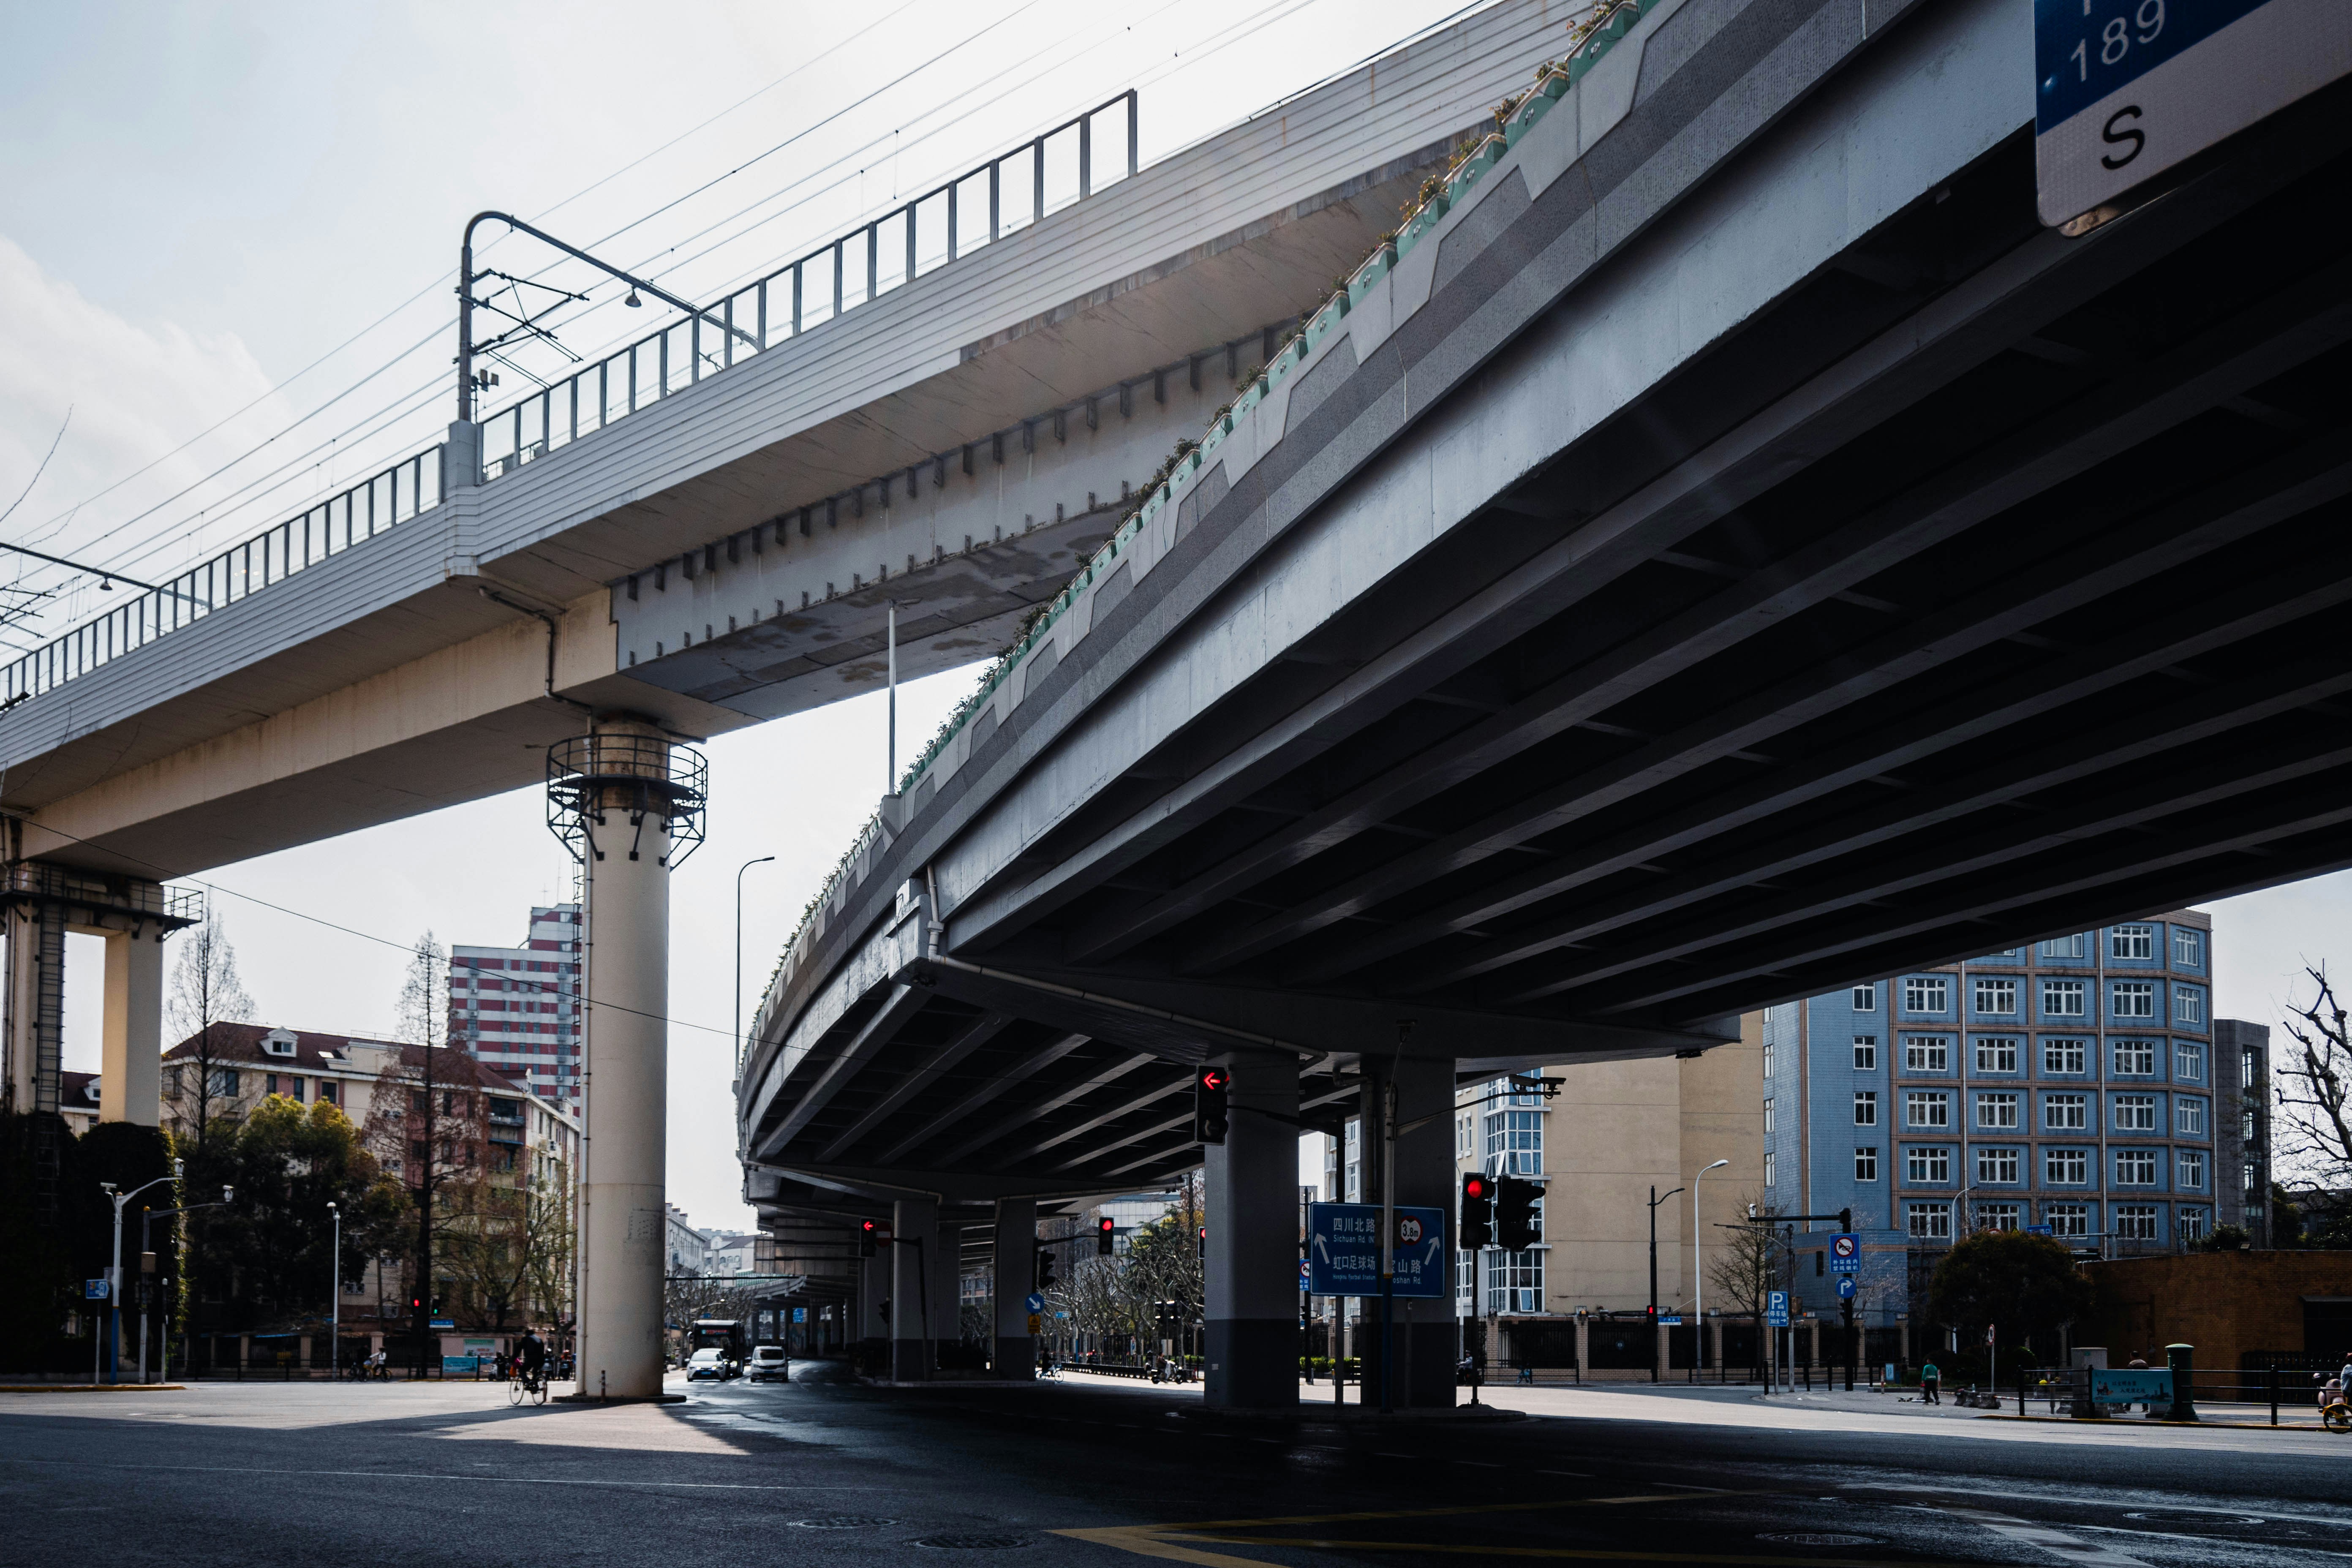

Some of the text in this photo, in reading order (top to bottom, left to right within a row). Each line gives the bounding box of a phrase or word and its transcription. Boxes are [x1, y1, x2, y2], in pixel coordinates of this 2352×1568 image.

[2070, 0, 2165, 82] 189
[2102, 106, 2145, 170] S
[1334, 1217, 1375, 1233] 四川北路
[1403, 1224, 1418, 1237] 3.8m
[1333, 1234, 1356, 1243] Sichuan
[1333, 1255, 1376, 1270] 虹口足球场
[1393, 1276, 1410, 1284] oshan
[1772, 1293, 1783, 1309] P
